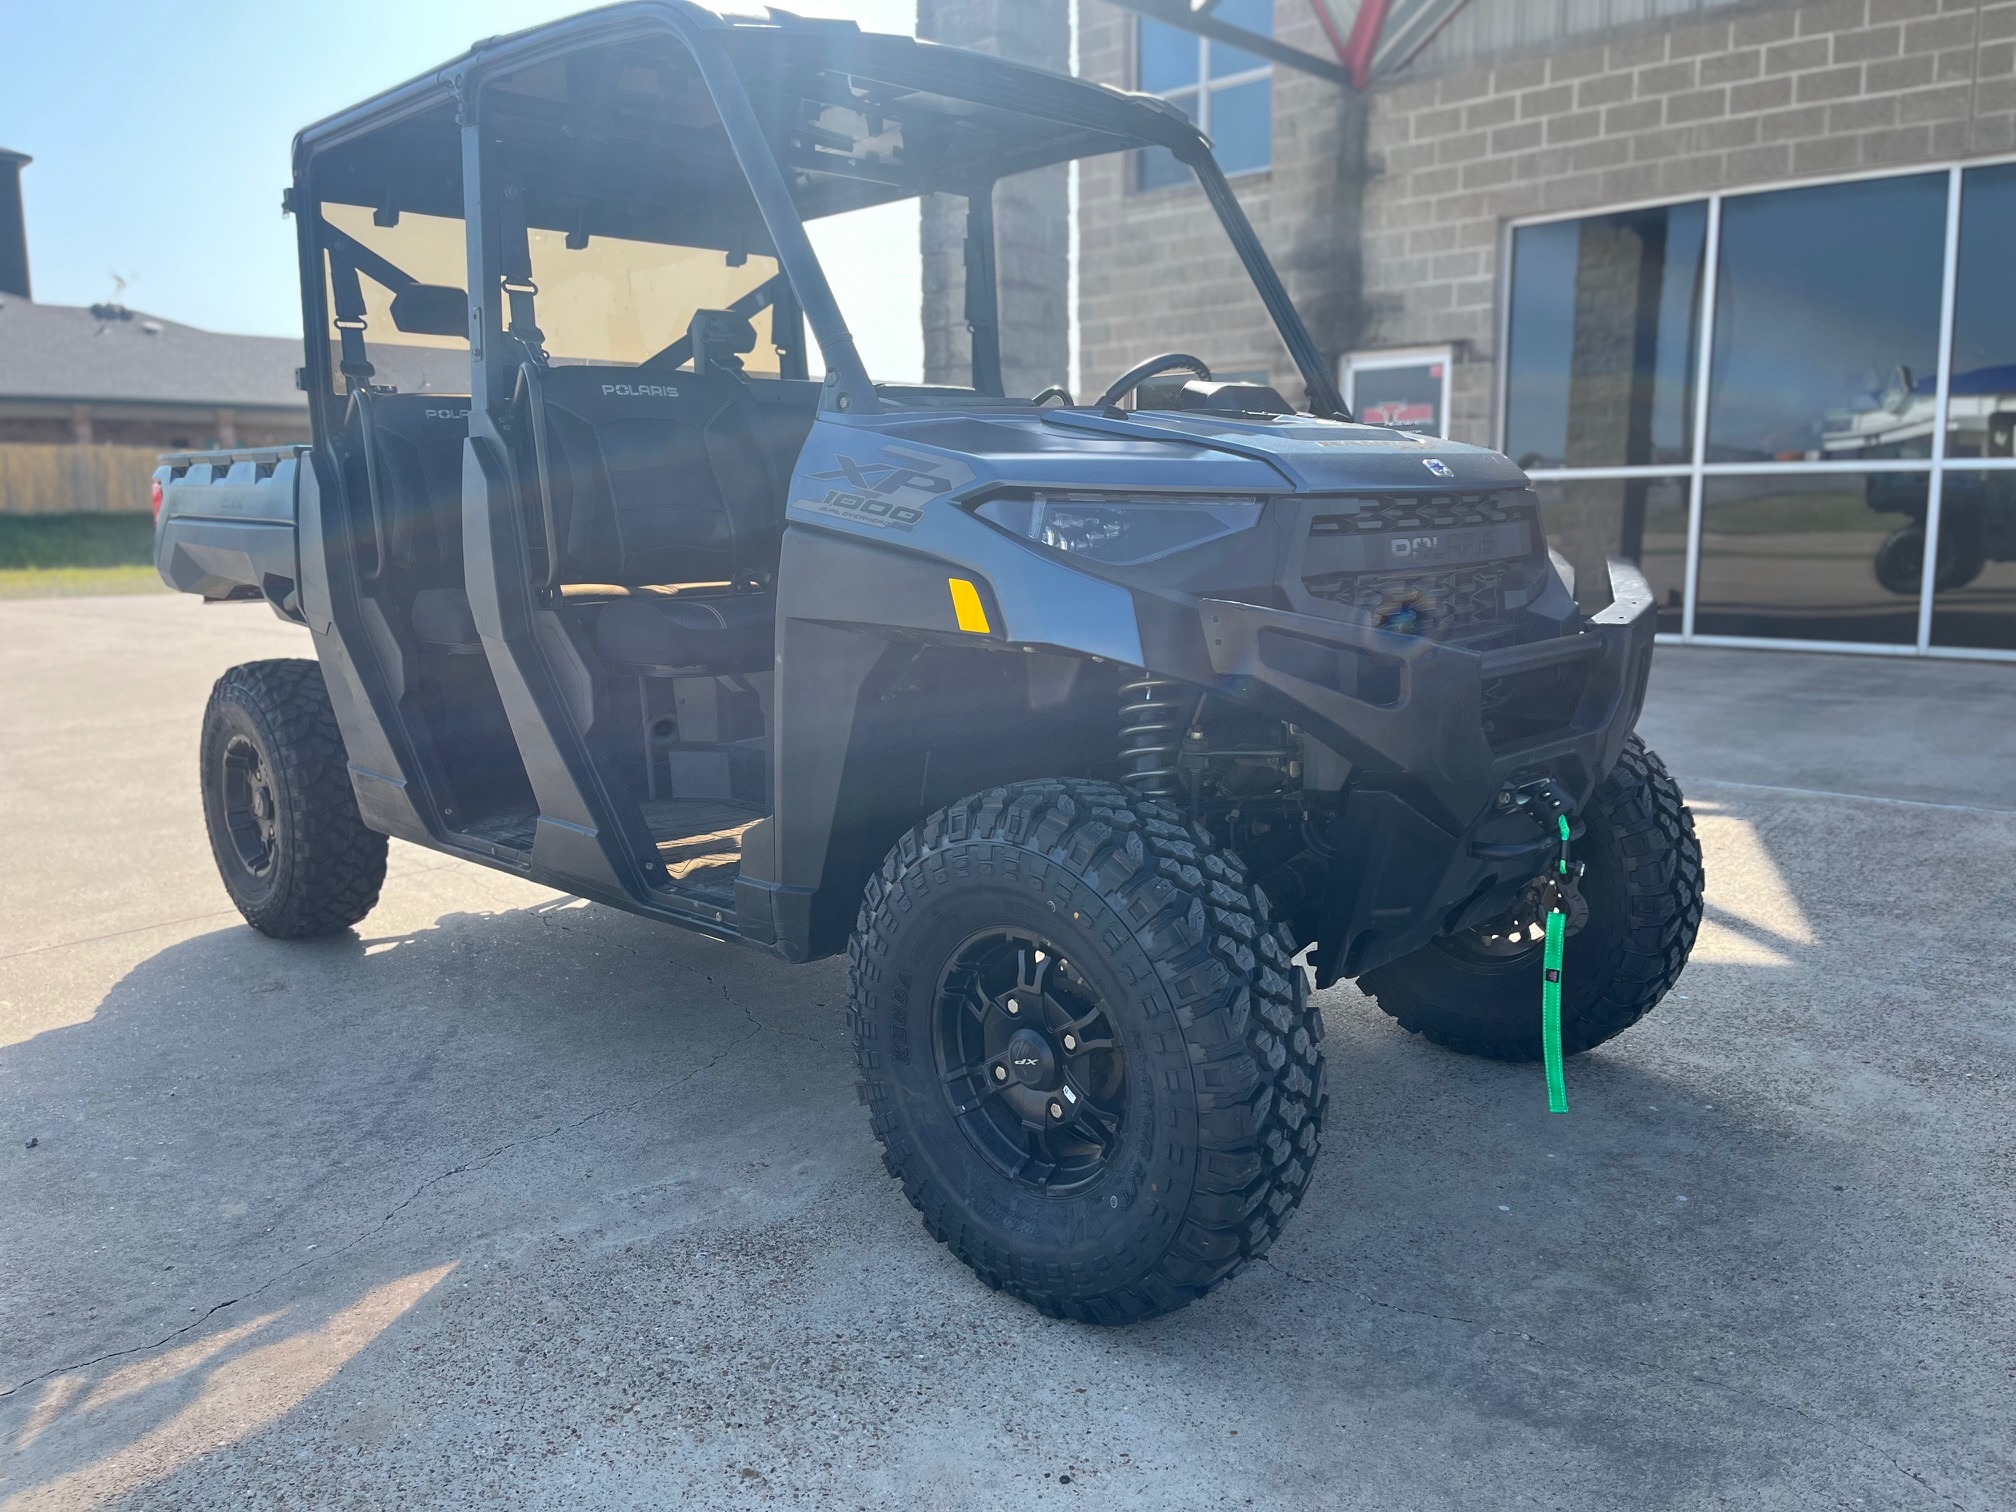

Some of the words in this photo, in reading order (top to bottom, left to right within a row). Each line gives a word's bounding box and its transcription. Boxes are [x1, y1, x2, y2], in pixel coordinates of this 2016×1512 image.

[601, 384, 680, 397] POLARIS
[804, 454, 953, 494] XP
[819, 506, 841, 515] DUAL
[841, 511, 891, 526] OVERHEAD
[821, 489, 925, 526] 1000
[1014, 1058, 1039, 1066] XP
